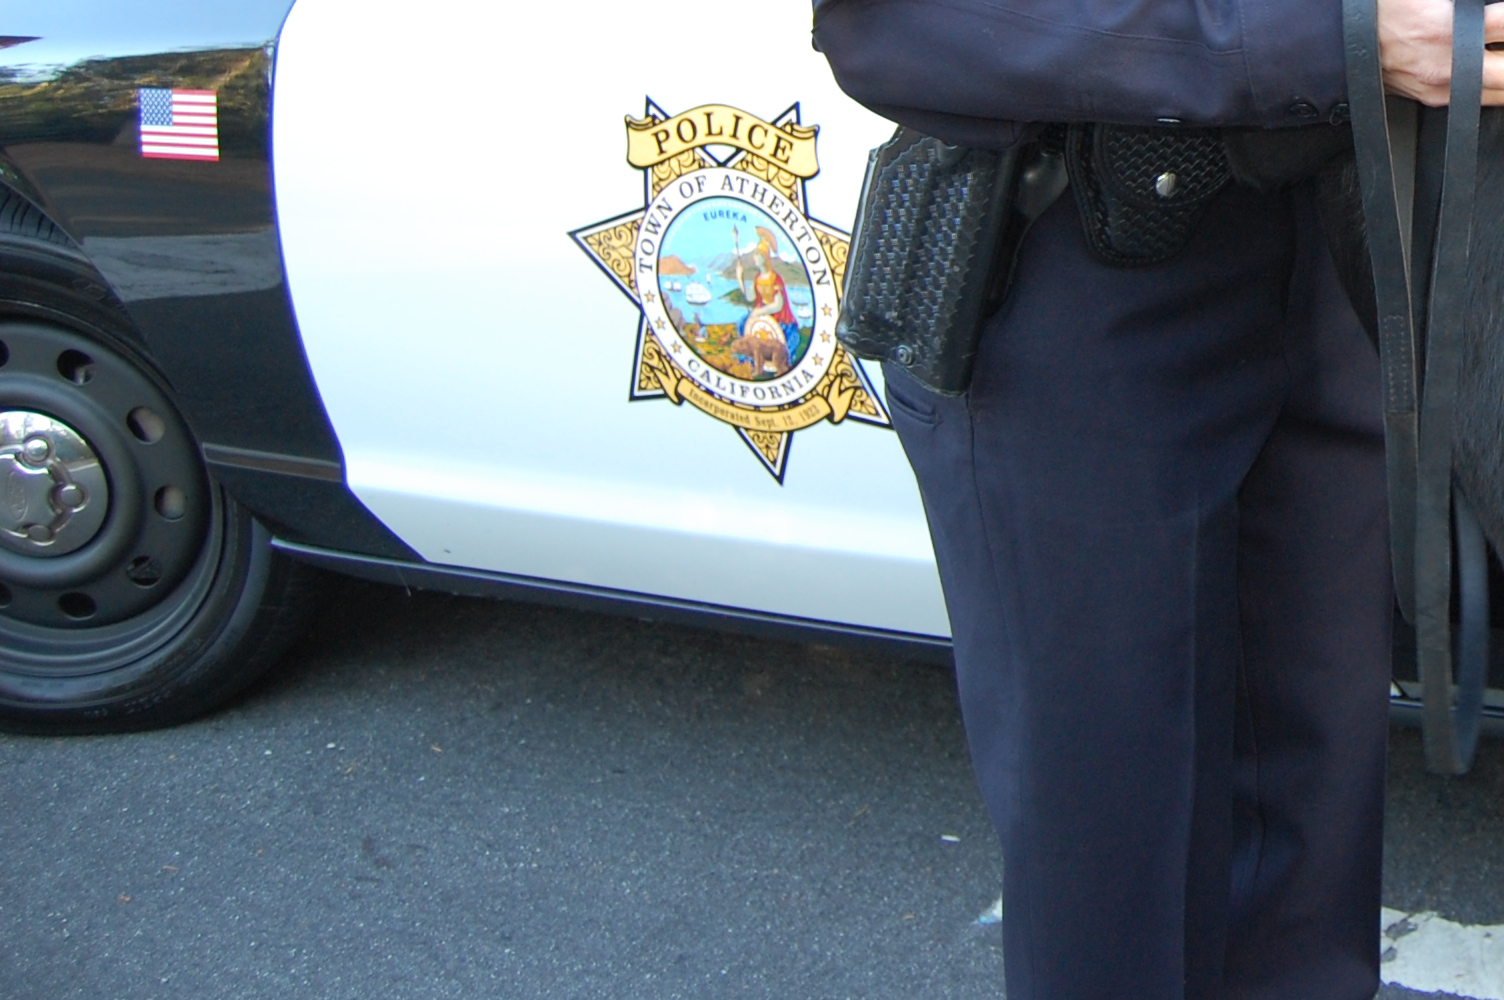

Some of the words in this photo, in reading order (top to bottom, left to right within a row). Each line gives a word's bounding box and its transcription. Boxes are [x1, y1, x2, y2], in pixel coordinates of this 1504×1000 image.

[651, 111, 796, 165] POLICE
[639, 196, 676, 274] TOWN
[679, 175, 707, 200] OF
[720, 173, 831, 287] ATHERTON
[703, 209, 748, 223] EUREKA
[687, 359, 816, 401] CALIFORNIA
[689, 389, 750, 424] Incorporated
